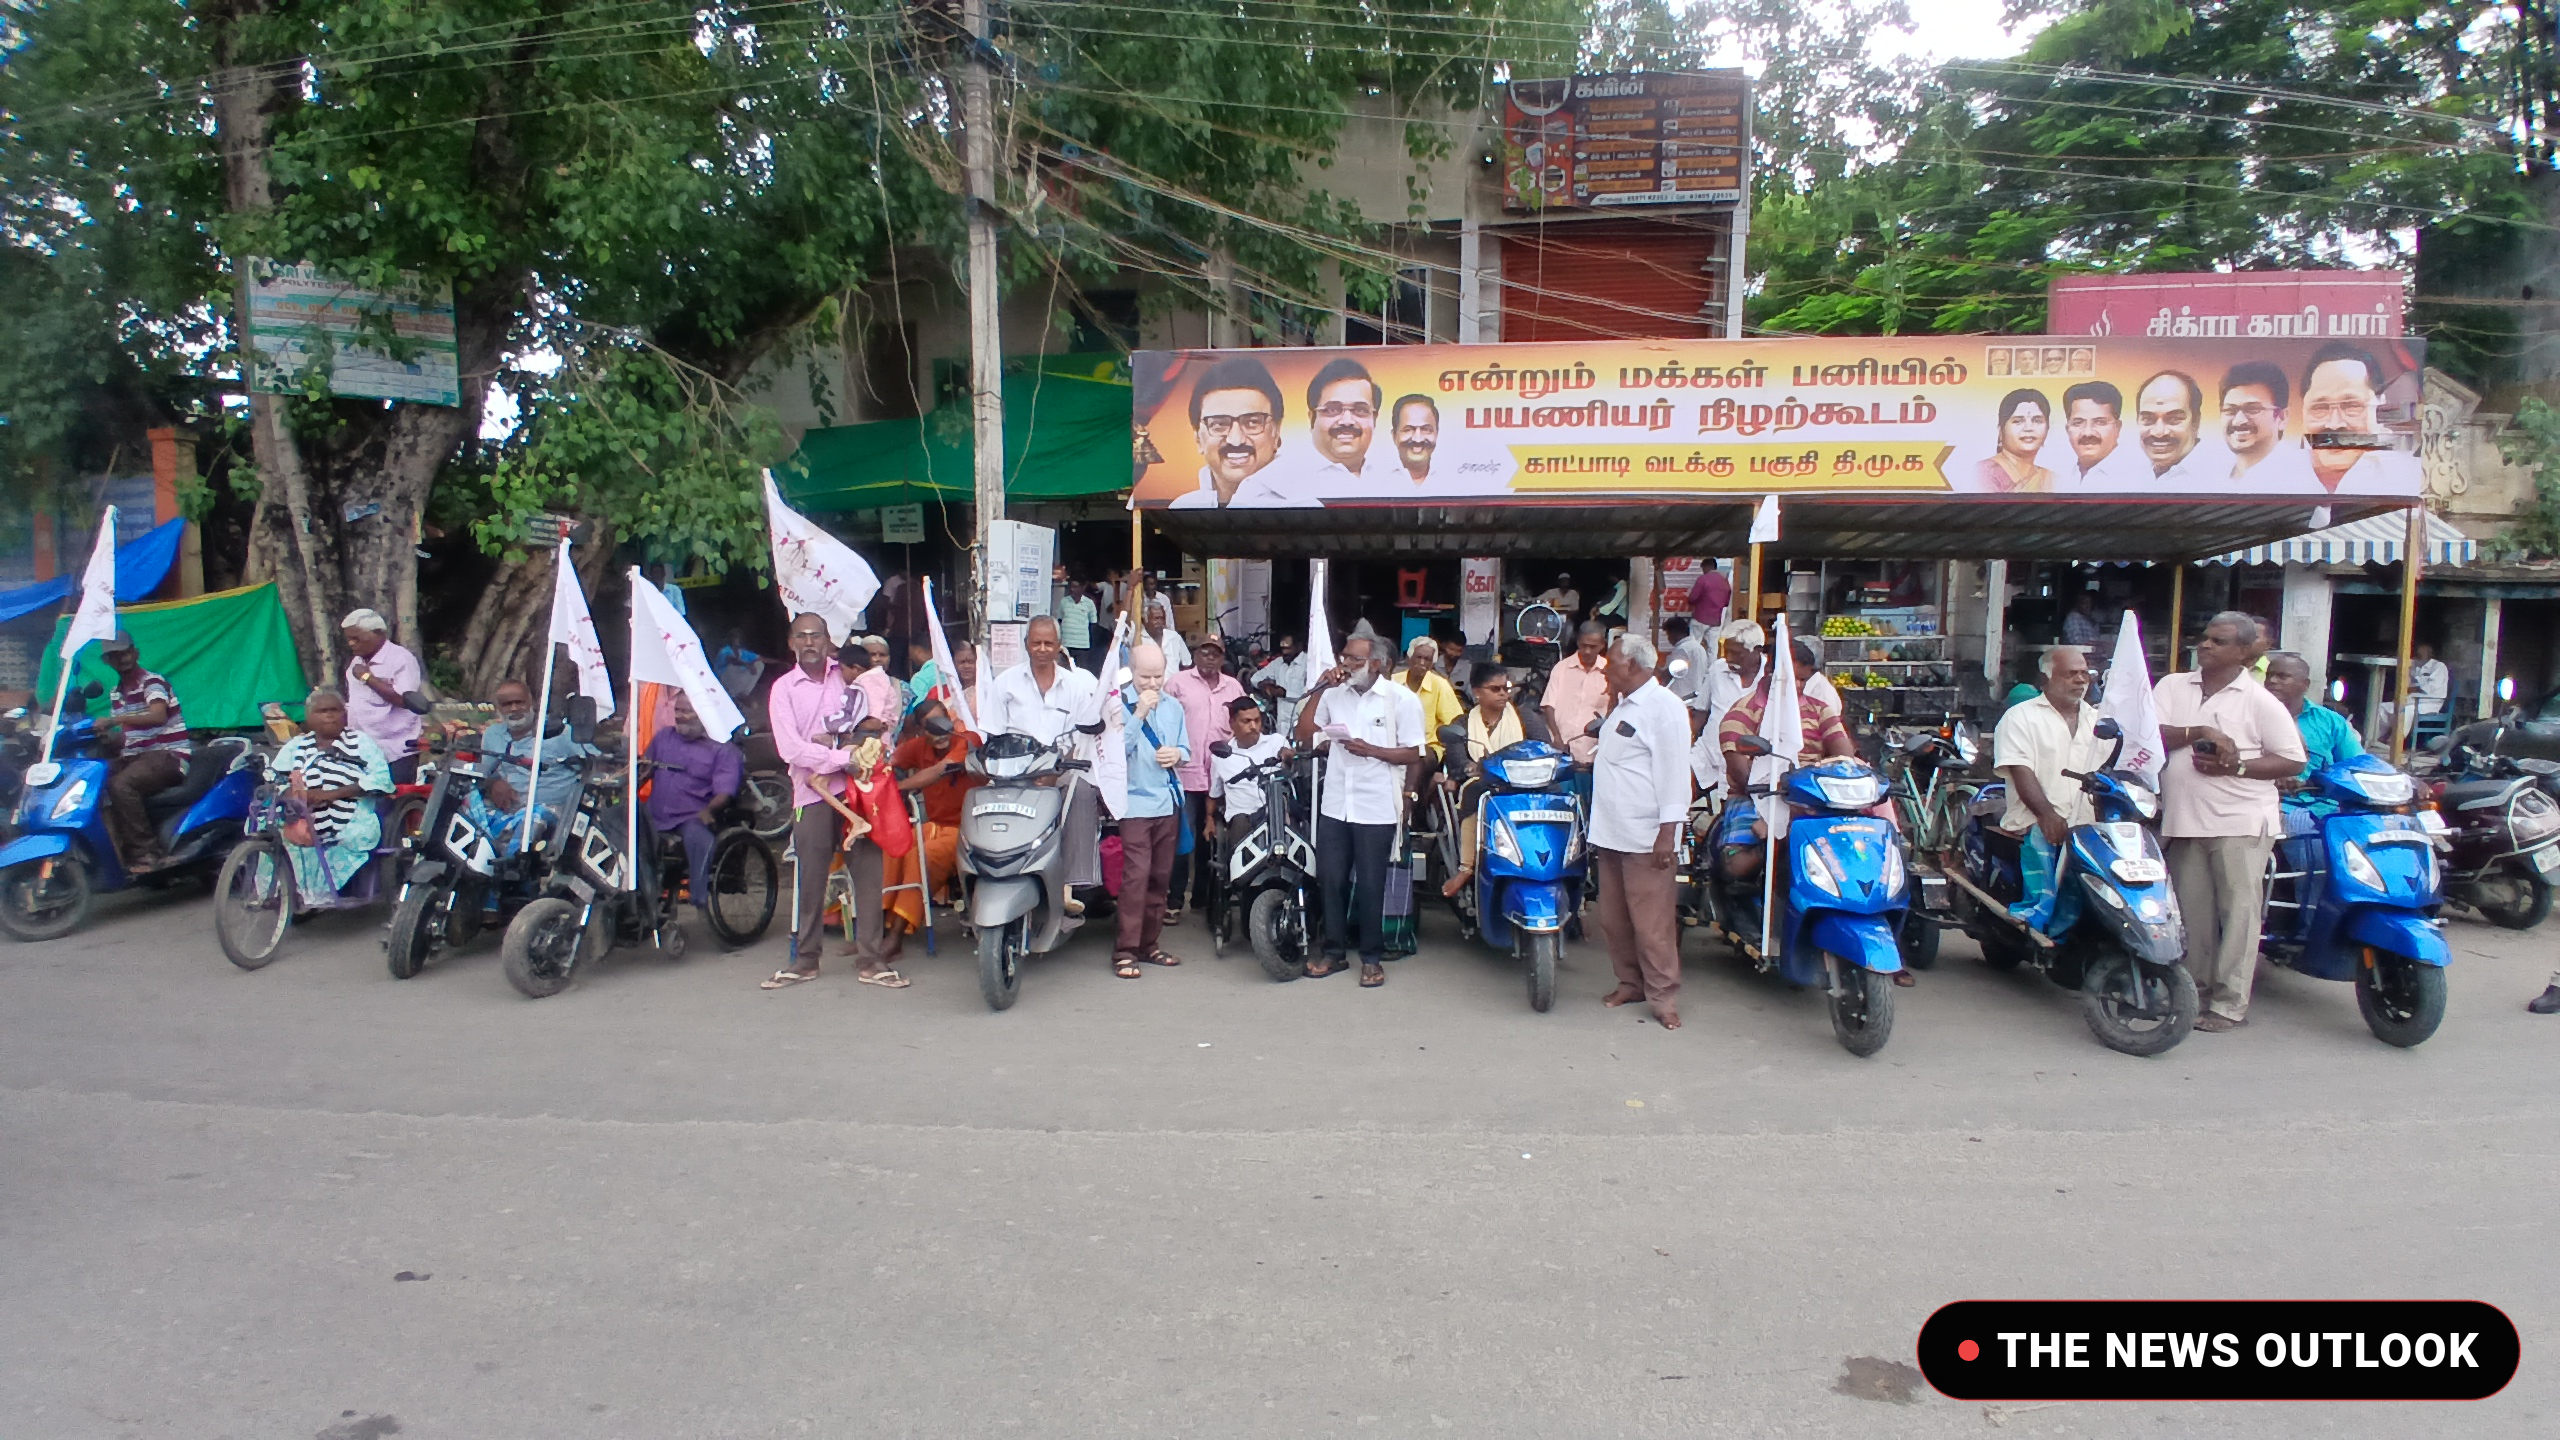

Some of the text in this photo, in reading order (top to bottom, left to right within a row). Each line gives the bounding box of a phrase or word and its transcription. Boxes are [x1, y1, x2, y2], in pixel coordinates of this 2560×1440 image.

[1438, 356, 1968, 399] என்றும் மக்கள் பணியில்
[1465, 395, 1938, 436] பயணியர் நிழற்கூடம்
[1524, 454, 1631, 478] காட்பாடி
[1645, 450, 1736, 477] வடக்கு
[1749, 450, 1819, 478] பகுதி
[1831, 449, 1924, 478] தி.மு.க
